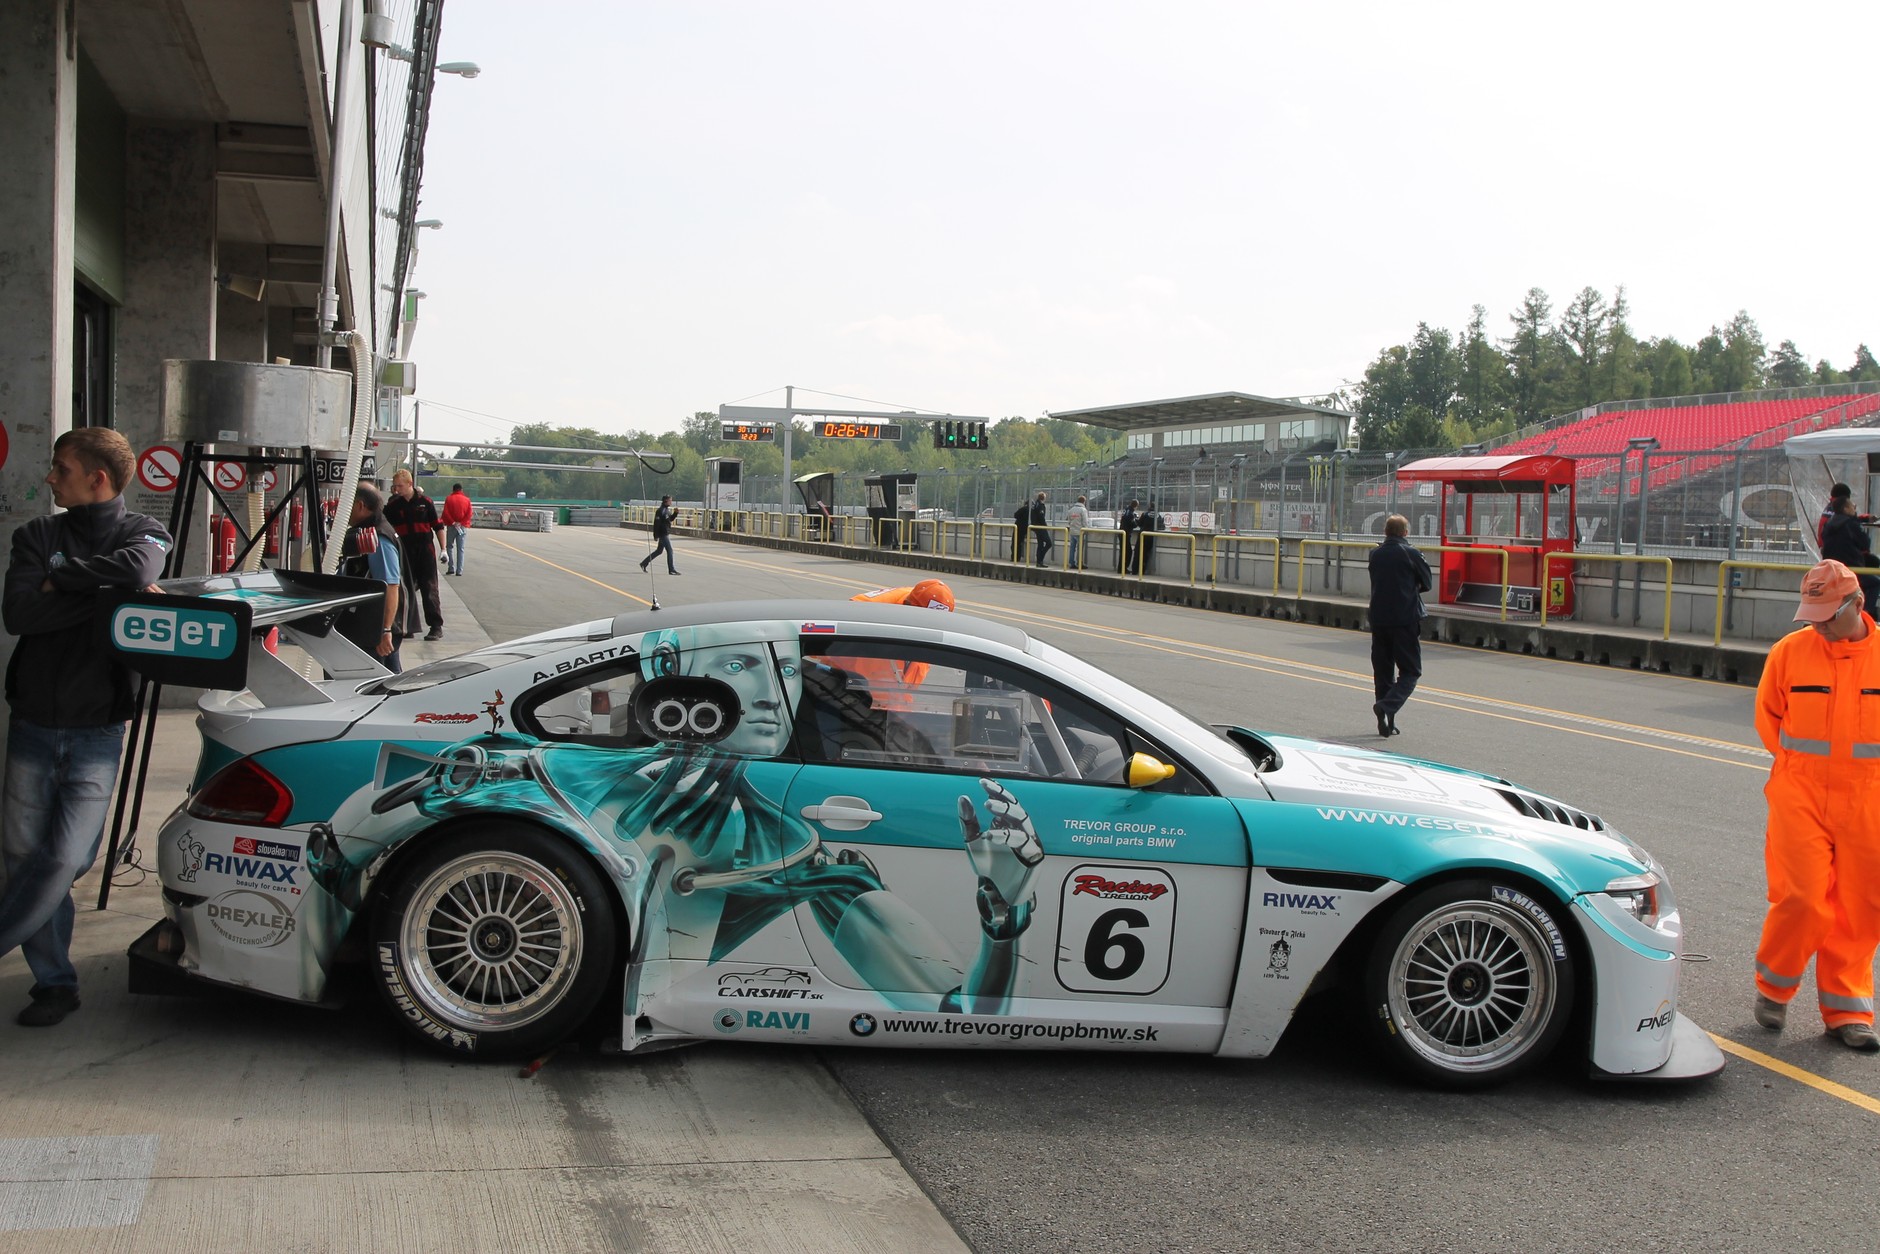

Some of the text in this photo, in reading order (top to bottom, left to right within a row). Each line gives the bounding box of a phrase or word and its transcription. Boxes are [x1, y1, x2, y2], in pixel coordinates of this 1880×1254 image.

[824, 423, 878, 438] 0:26:41
[1260, 482, 1302, 491] MONTER
[1270, 503, 1322, 512] RETAURACE
[556, 645, 637, 674] BARTA
[414, 712, 479, 724] Racing
[1064, 820, 1187, 836] TREVOR GROUP s.r.o.
[1071, 833, 1176, 848] original parts BMW
[205, 853, 297, 885] RIWAX
[236, 879, 258, 889] beauty
[1073, 875, 1168, 900] Racing
[1263, 893, 1336, 910] RIWAX
[207, 904, 296, 932] DREXLER
[1512, 893, 1565, 957] MICHELIN
[210, 919, 277, 946] ANTRIEBSTECHNOLOGIE
[1084, 907, 1150, 981] 6
[379, 945, 450, 1040] MICHELIN
[746, 1010, 810, 1030] RAVI
[883, 1018, 1159, 1041] www.trevorgroupbmw.sk
